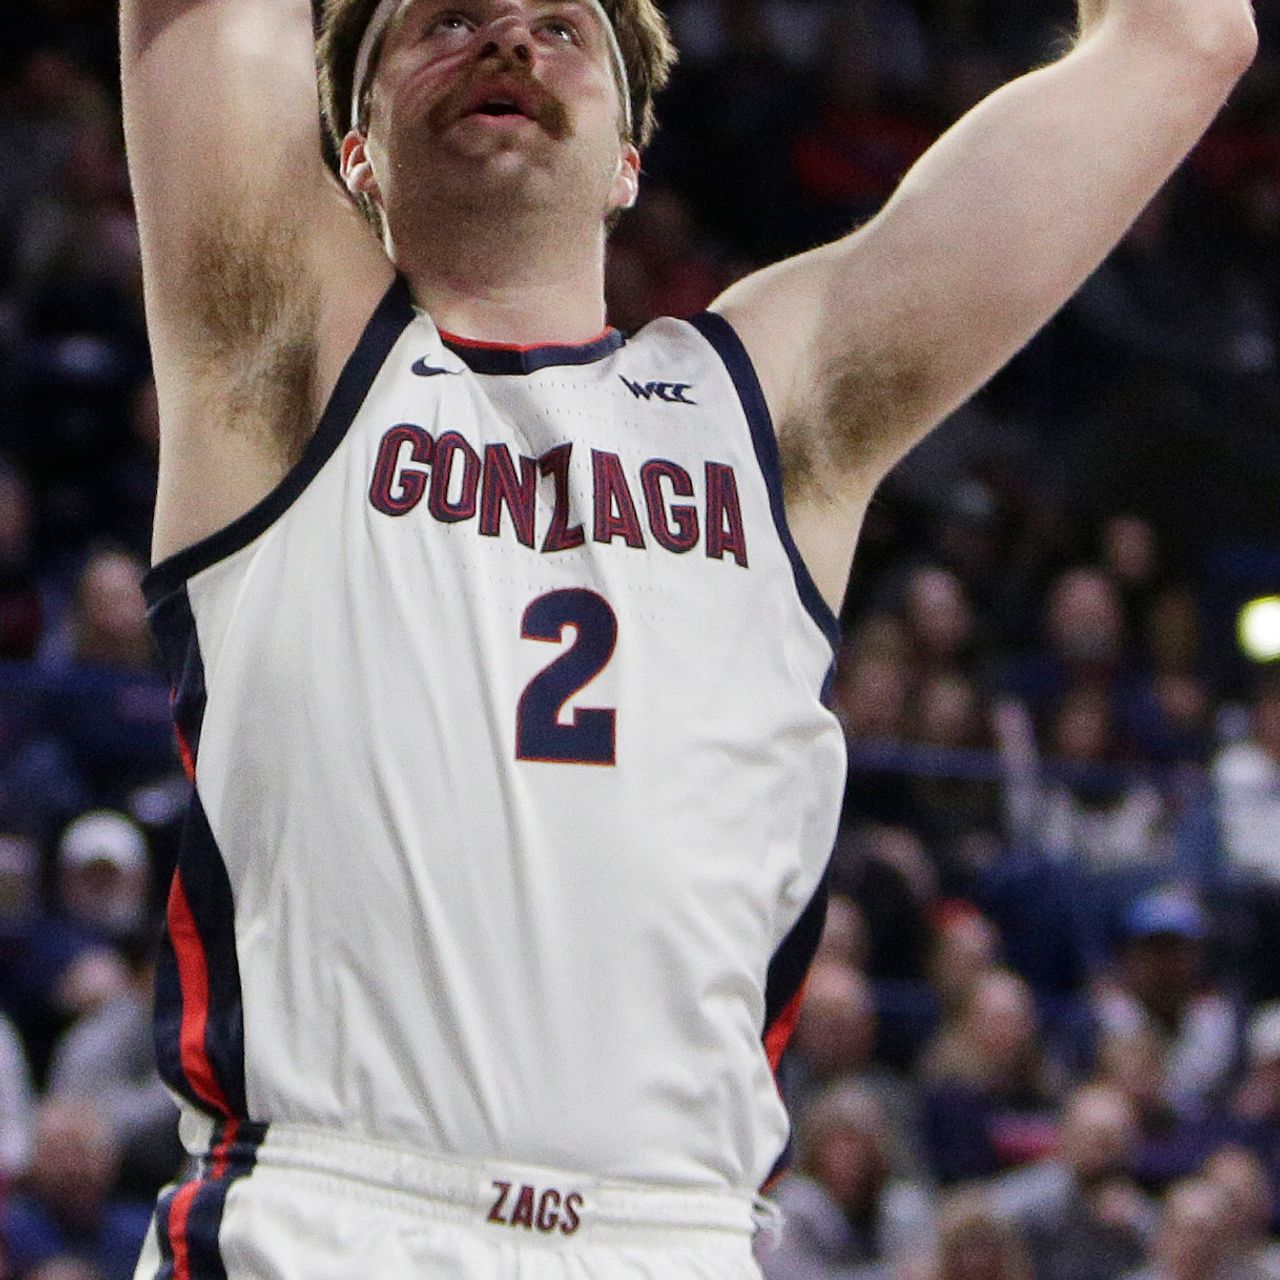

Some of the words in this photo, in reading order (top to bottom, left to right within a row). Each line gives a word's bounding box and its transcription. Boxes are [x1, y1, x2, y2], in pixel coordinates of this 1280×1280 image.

[617, 373, 698, 405] WCC
[369, 423, 749, 569] GONZAGA
[515, 586, 619, 767] 2
[487, 1180, 584, 1236] ZAGS
